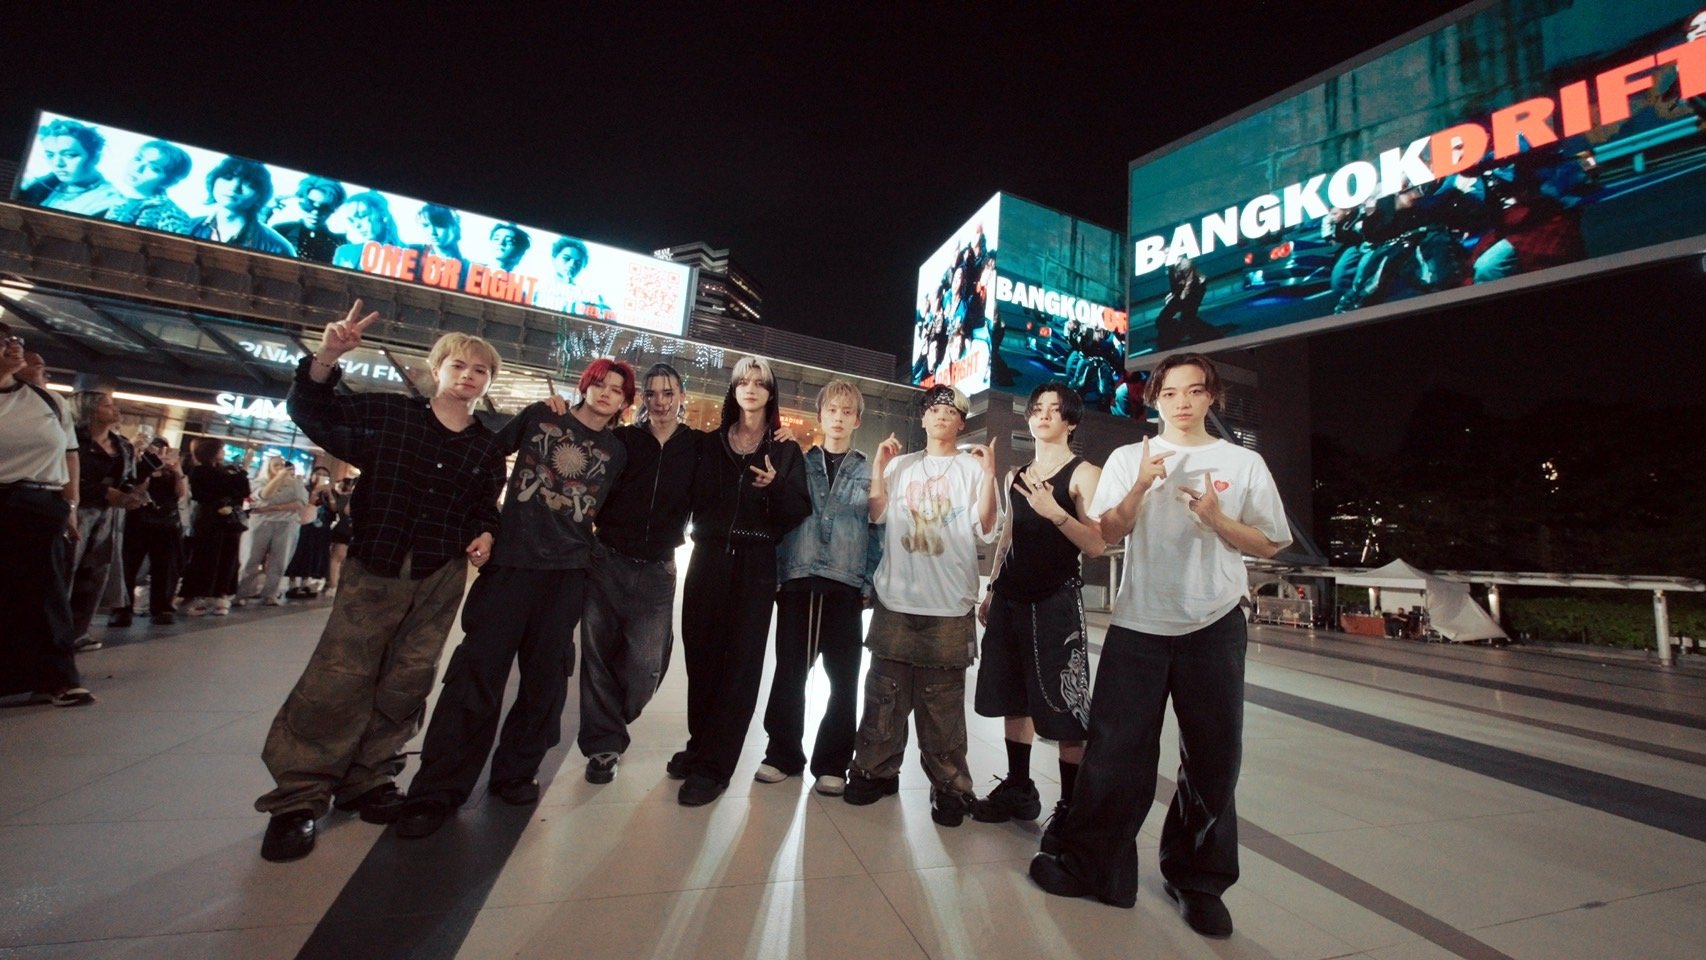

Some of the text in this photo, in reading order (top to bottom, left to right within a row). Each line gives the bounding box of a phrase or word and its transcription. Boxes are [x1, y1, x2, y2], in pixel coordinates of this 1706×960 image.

[362, 242, 418, 281] ONE
[421, 253, 462, 289] OR
[465, 260, 538, 306] EIGHT
[215, 392, 291, 421] SIAM
